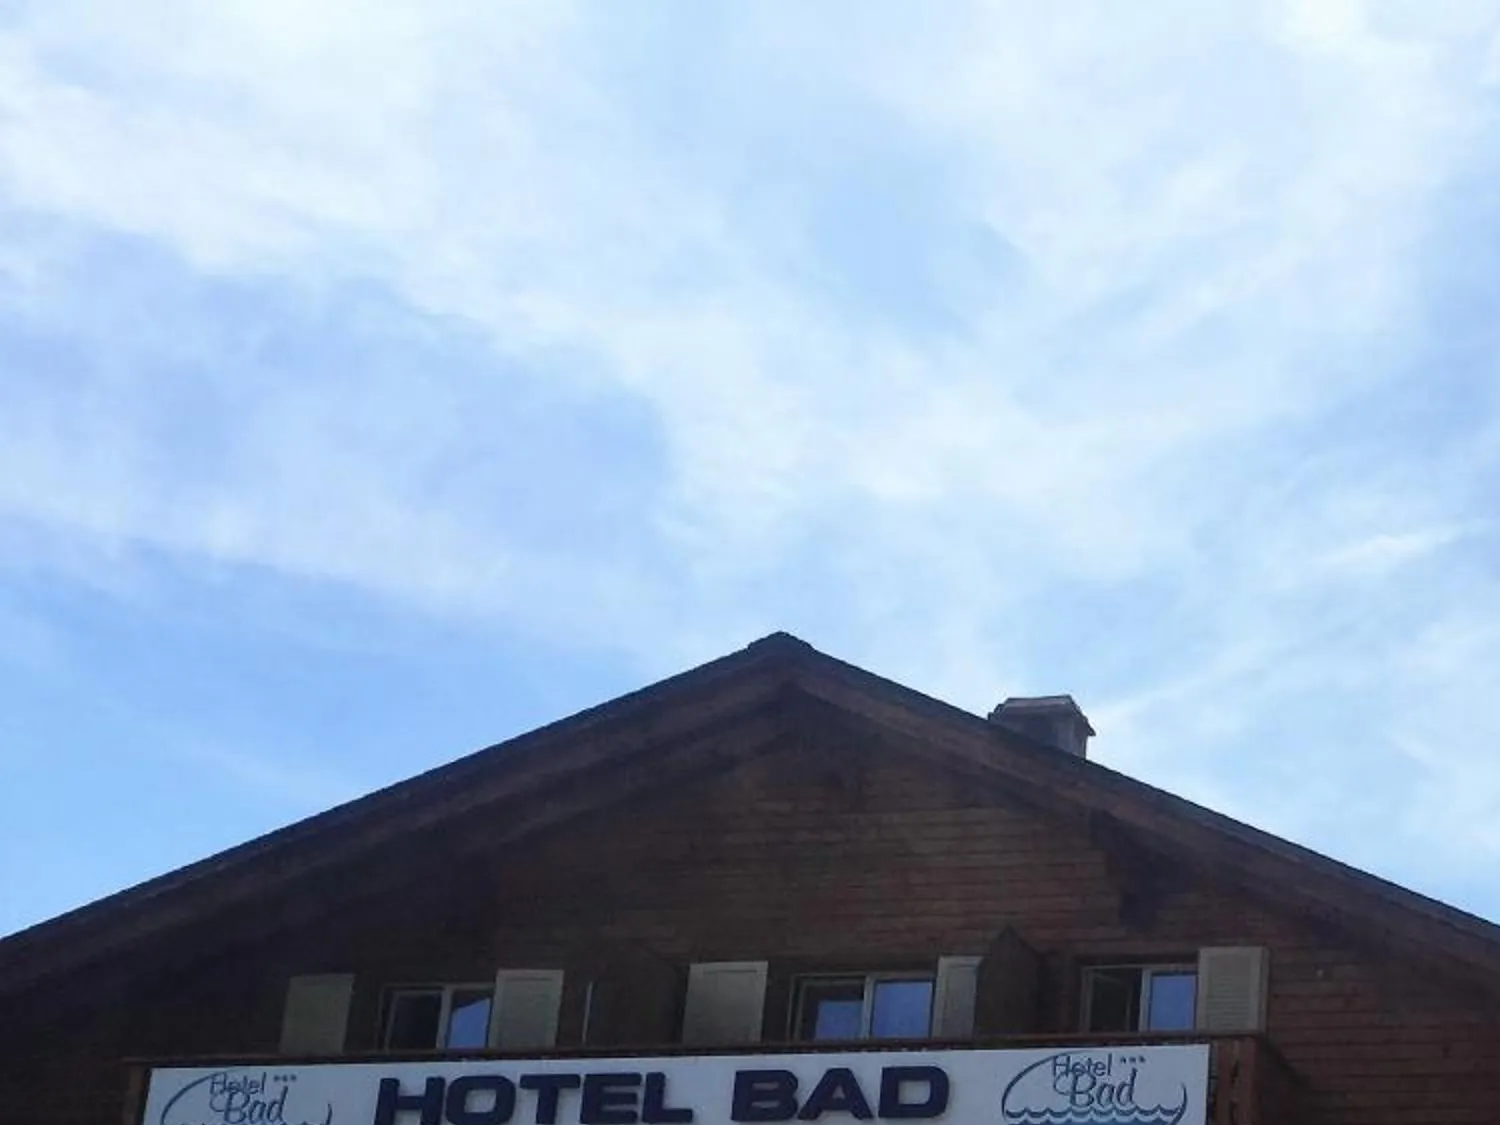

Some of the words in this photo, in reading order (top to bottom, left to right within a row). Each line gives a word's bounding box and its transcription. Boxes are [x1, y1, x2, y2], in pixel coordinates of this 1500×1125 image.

[209, 1071, 267, 1095] Hotel
[1053, 1053, 1112, 1077] Hotel
[209, 1085, 288, 1124] Bad
[730, 1065, 950, 1122] BAD
[1053, 1068, 1138, 1107] Bad
